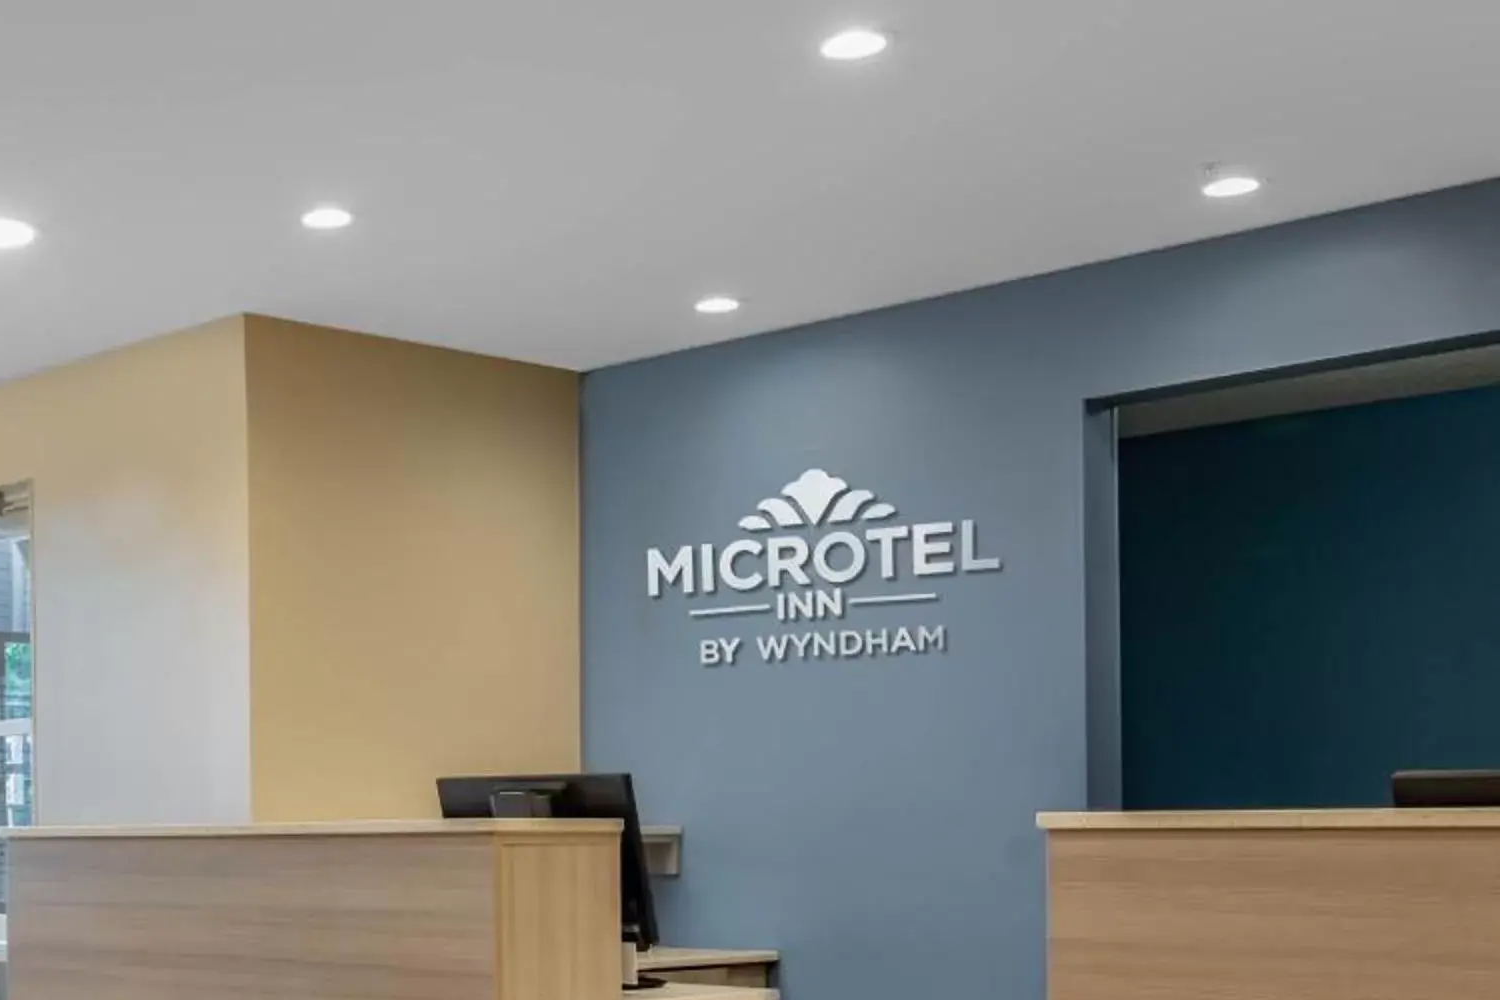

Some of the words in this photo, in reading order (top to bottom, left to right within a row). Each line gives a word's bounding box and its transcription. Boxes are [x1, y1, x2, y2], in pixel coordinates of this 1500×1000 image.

[647, 519, 1001, 597] MICROTEL
[777, 588, 844, 620] INN
[700, 637, 741, 664] BY
[757, 626, 946, 662] WYNDHAM
